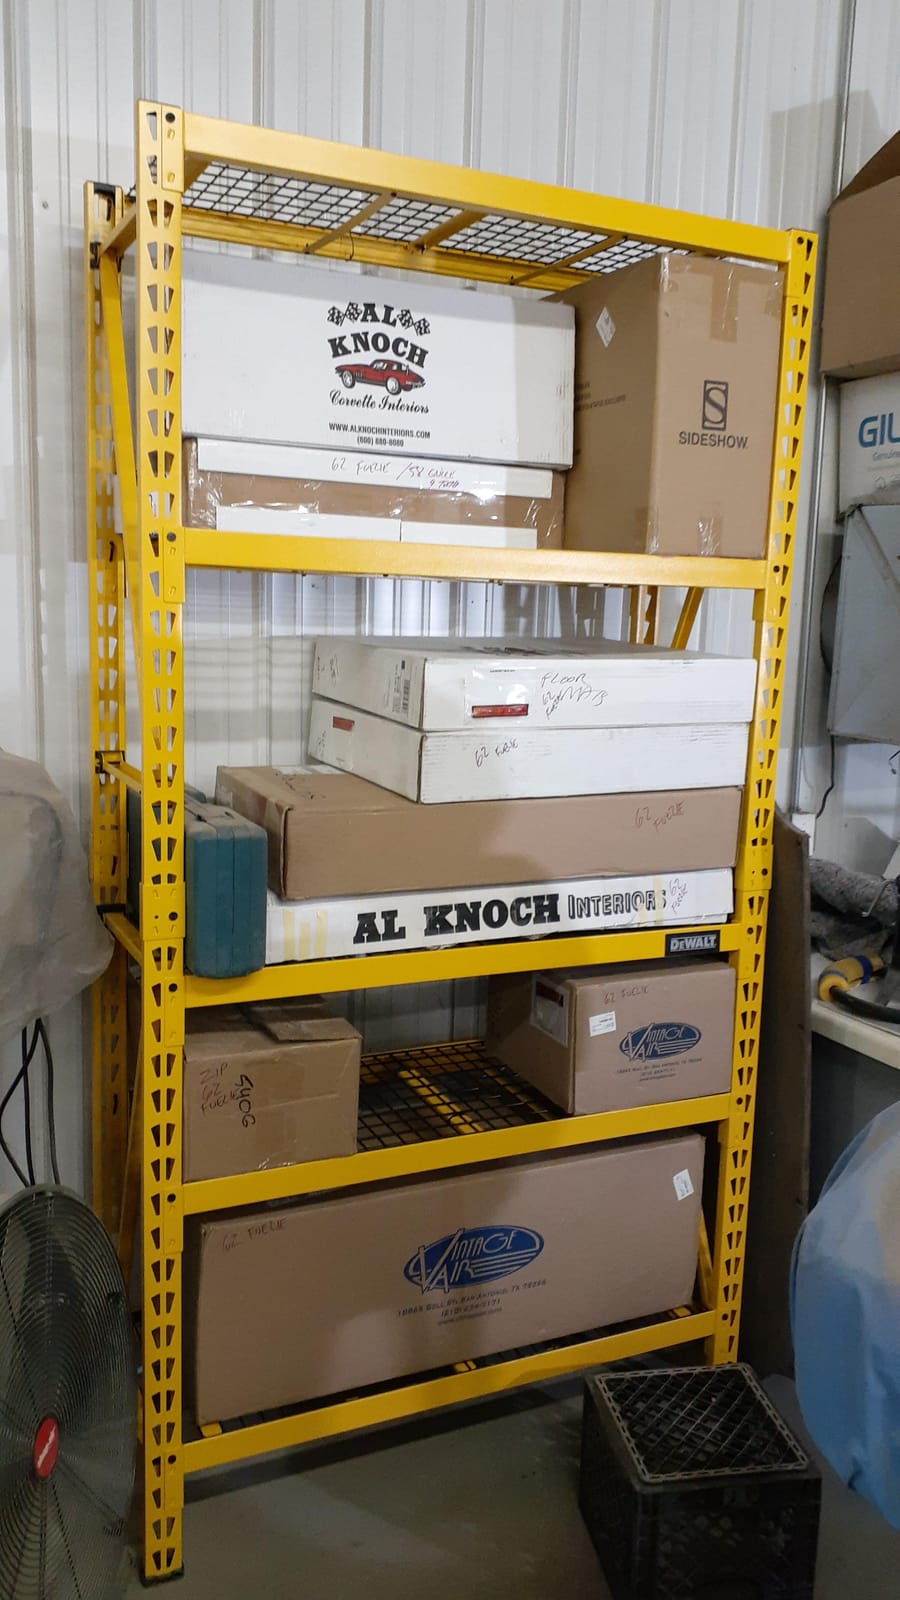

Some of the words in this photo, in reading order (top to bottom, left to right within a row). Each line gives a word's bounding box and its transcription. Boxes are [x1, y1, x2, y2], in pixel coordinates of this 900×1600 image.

[360, 302, 397, 328] AL
[327, 331, 429, 368] KNOCH
[329, 389, 376, 409] Corvette
[378, 395, 430, 414] Interiors
[328, 422, 431, 439] WWW.ALKNOCHINTERIORS.COM
[678, 430, 749, 449] SIDESHOW
[353, 910, 406, 944] AL
[424, 894, 560, 937] KNOCH
[568, 890, 667, 920] INTERIORS
